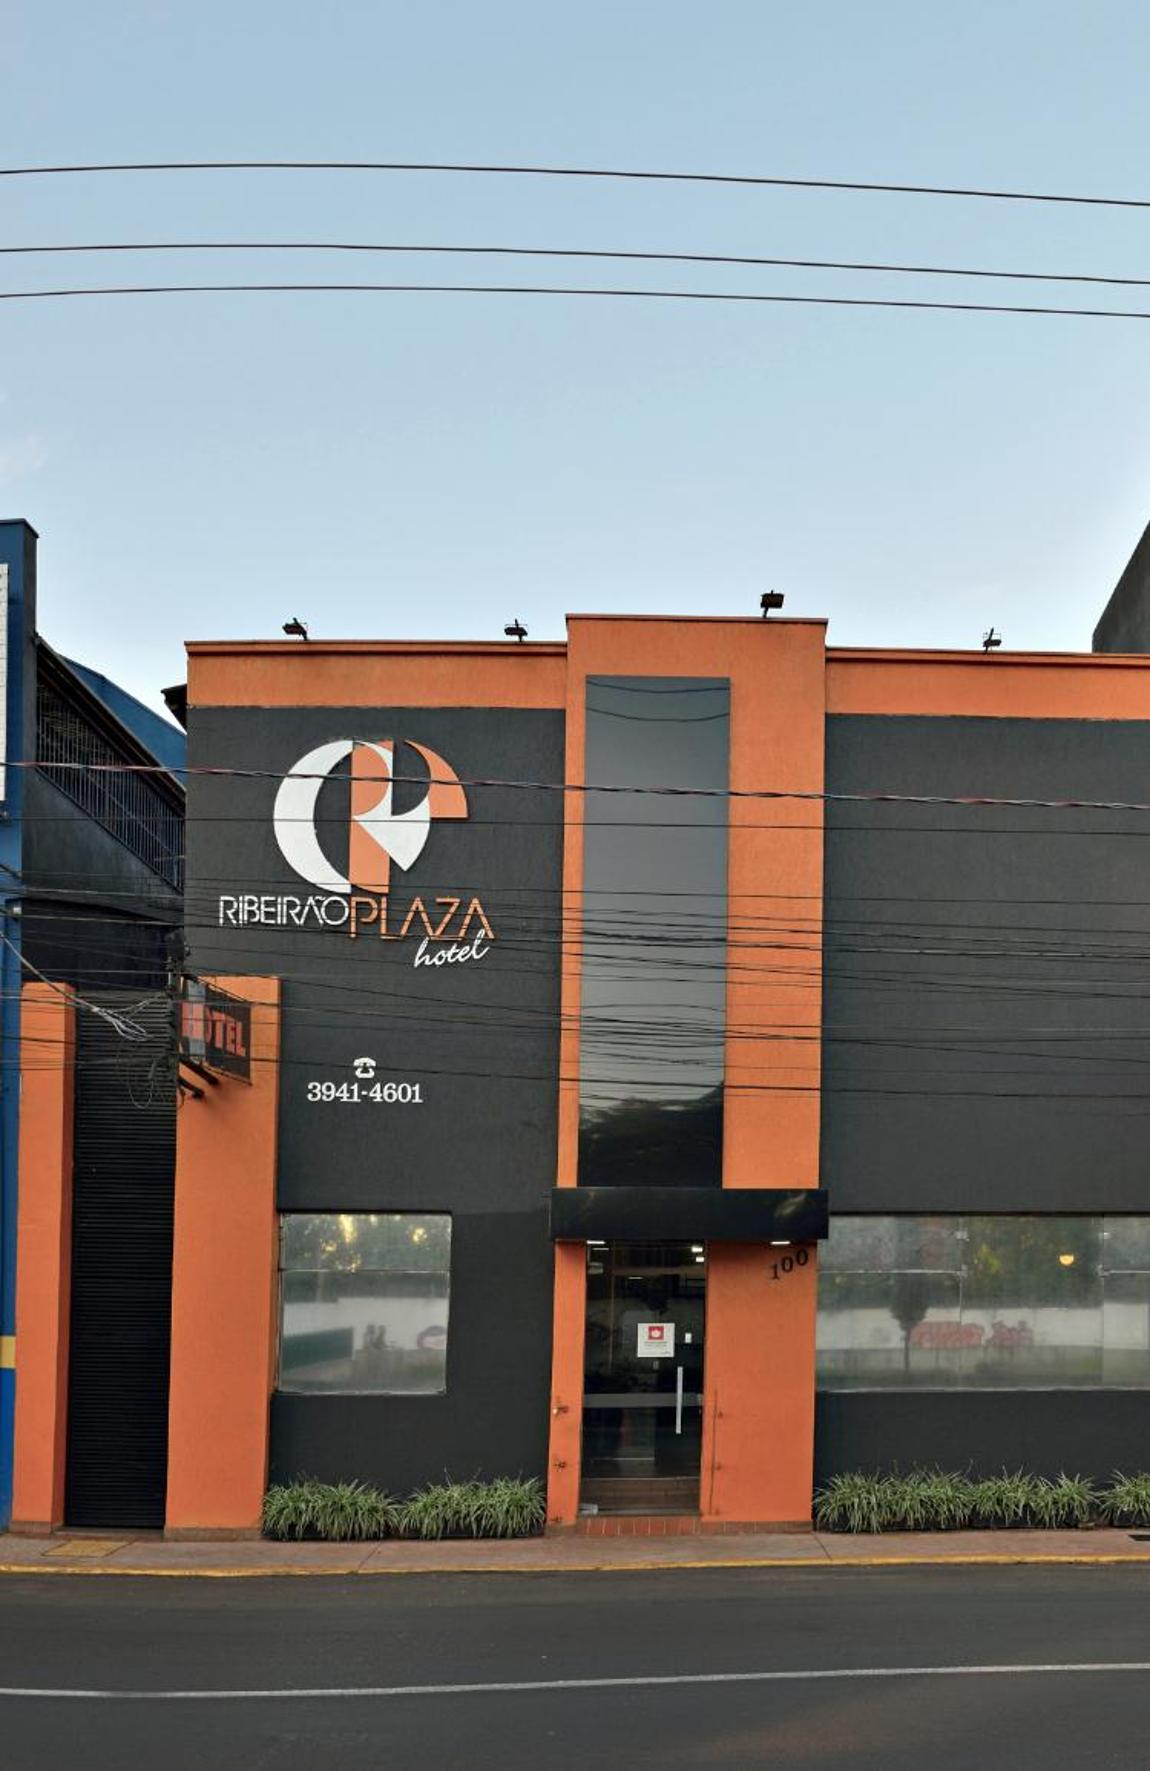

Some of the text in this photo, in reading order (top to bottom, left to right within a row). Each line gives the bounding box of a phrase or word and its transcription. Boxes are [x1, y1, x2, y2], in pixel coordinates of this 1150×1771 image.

[349, 896, 496, 941] PLAZA
[414, 928, 491, 968] hotel
[307, 1081, 423, 1103] 3941-4601
[769, 1249, 809, 1281] 100
